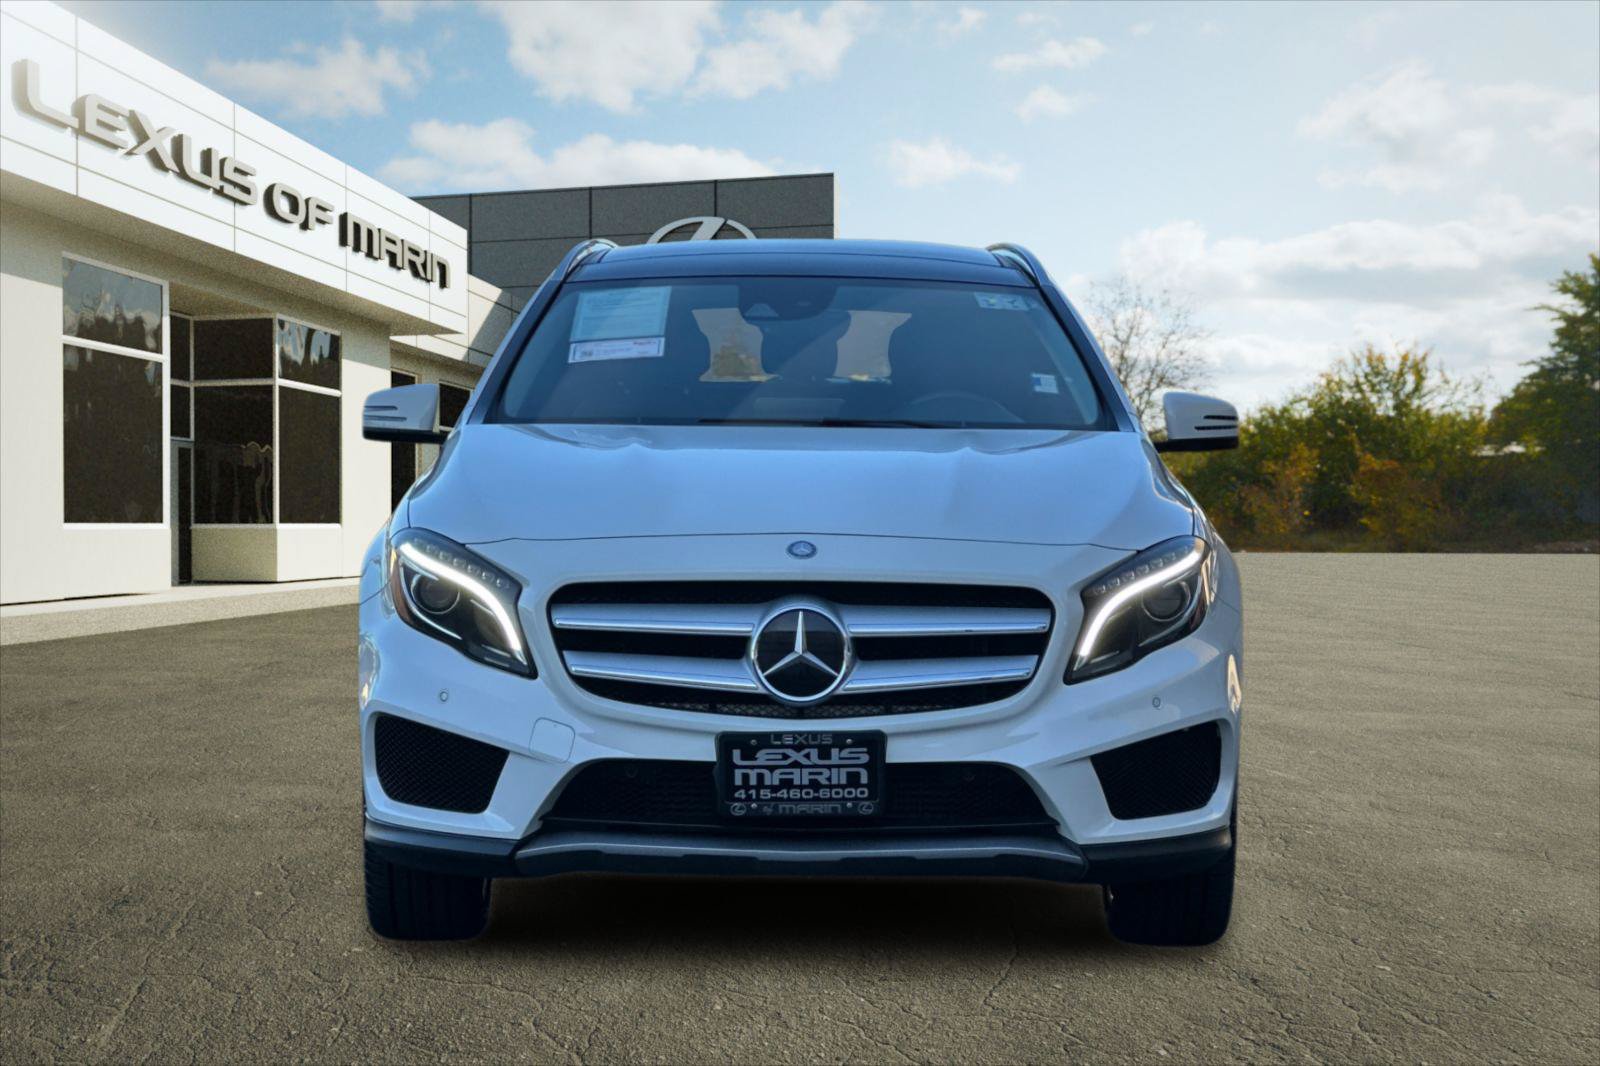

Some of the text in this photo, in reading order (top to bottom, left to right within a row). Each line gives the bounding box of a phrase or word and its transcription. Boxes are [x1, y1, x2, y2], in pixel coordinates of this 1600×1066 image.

[11, 58, 451, 289] LEXUS OF MARIN
[770, 734, 833, 745] LEXUS
[732, 748, 870, 766] LEXUS
[734, 767, 869, 786] MARIN
[734, 788, 869, 800] 415-460-6000
[778, 803, 842, 815] MARIN
